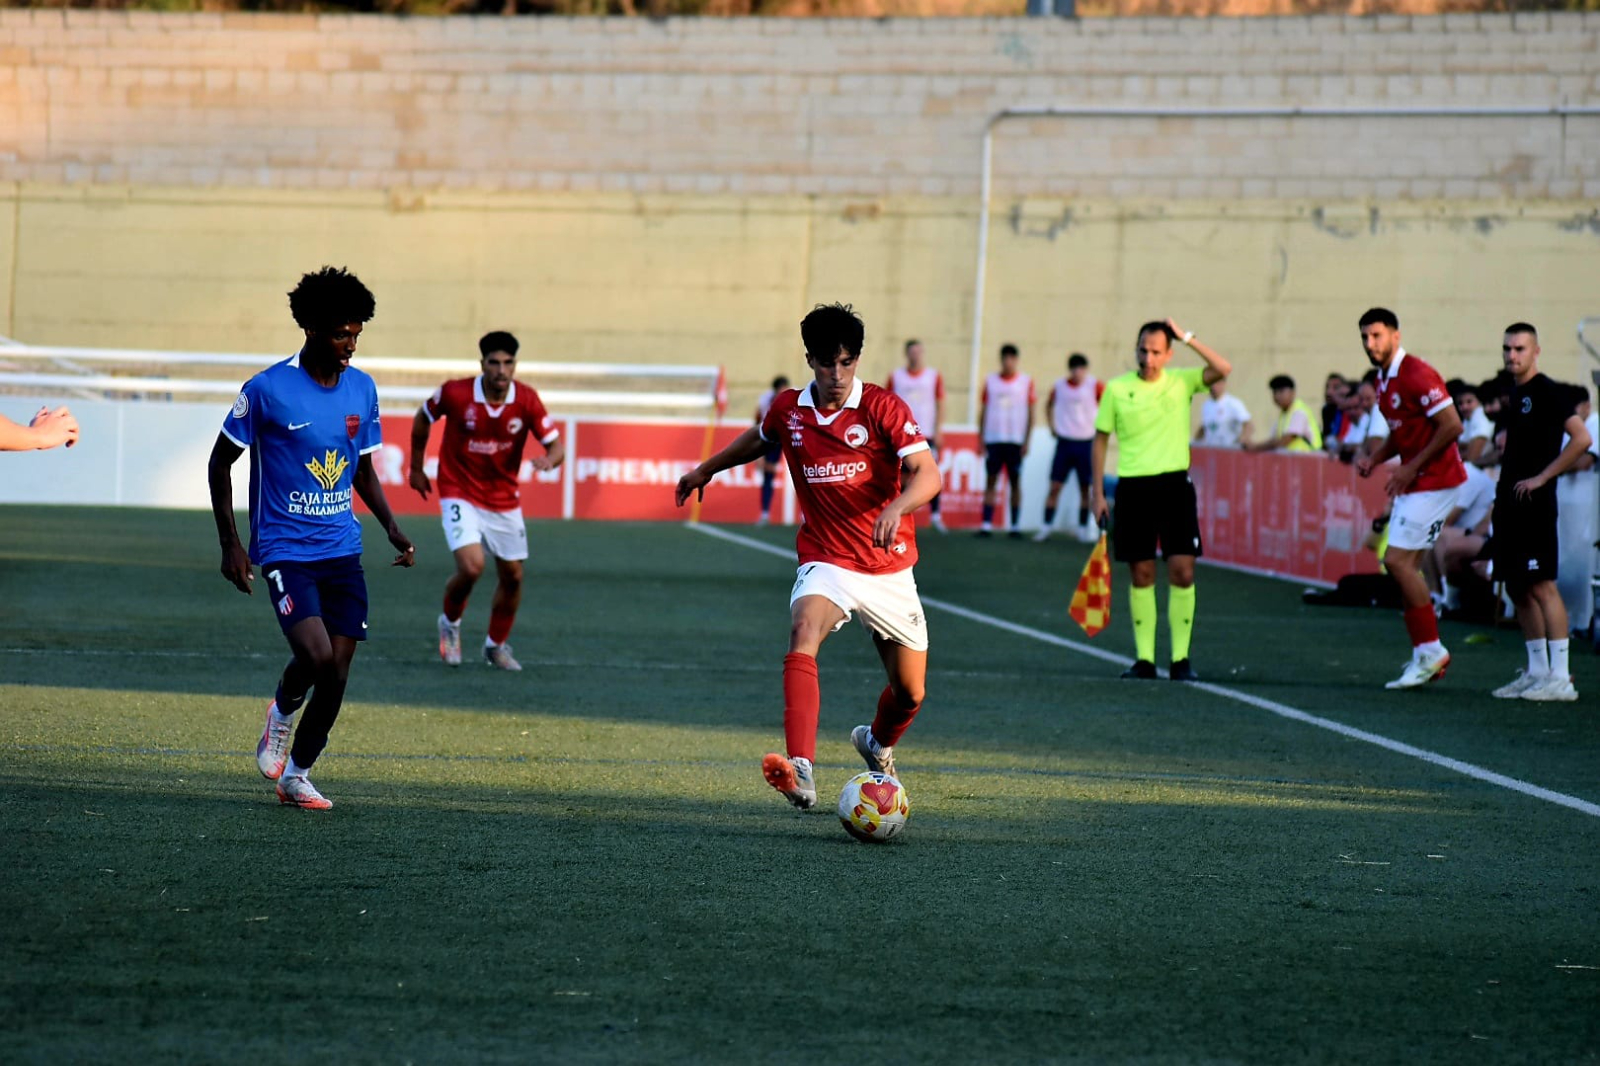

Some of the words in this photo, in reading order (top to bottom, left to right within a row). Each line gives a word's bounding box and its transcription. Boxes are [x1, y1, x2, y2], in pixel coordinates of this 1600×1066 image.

[803, 461, 867, 478] telefurgo
[289, 491, 321, 506] CAJA
[322, 488, 351, 504] RURAL
[288, 503, 303, 514] DE
[450, 503, 462, 522] 3
